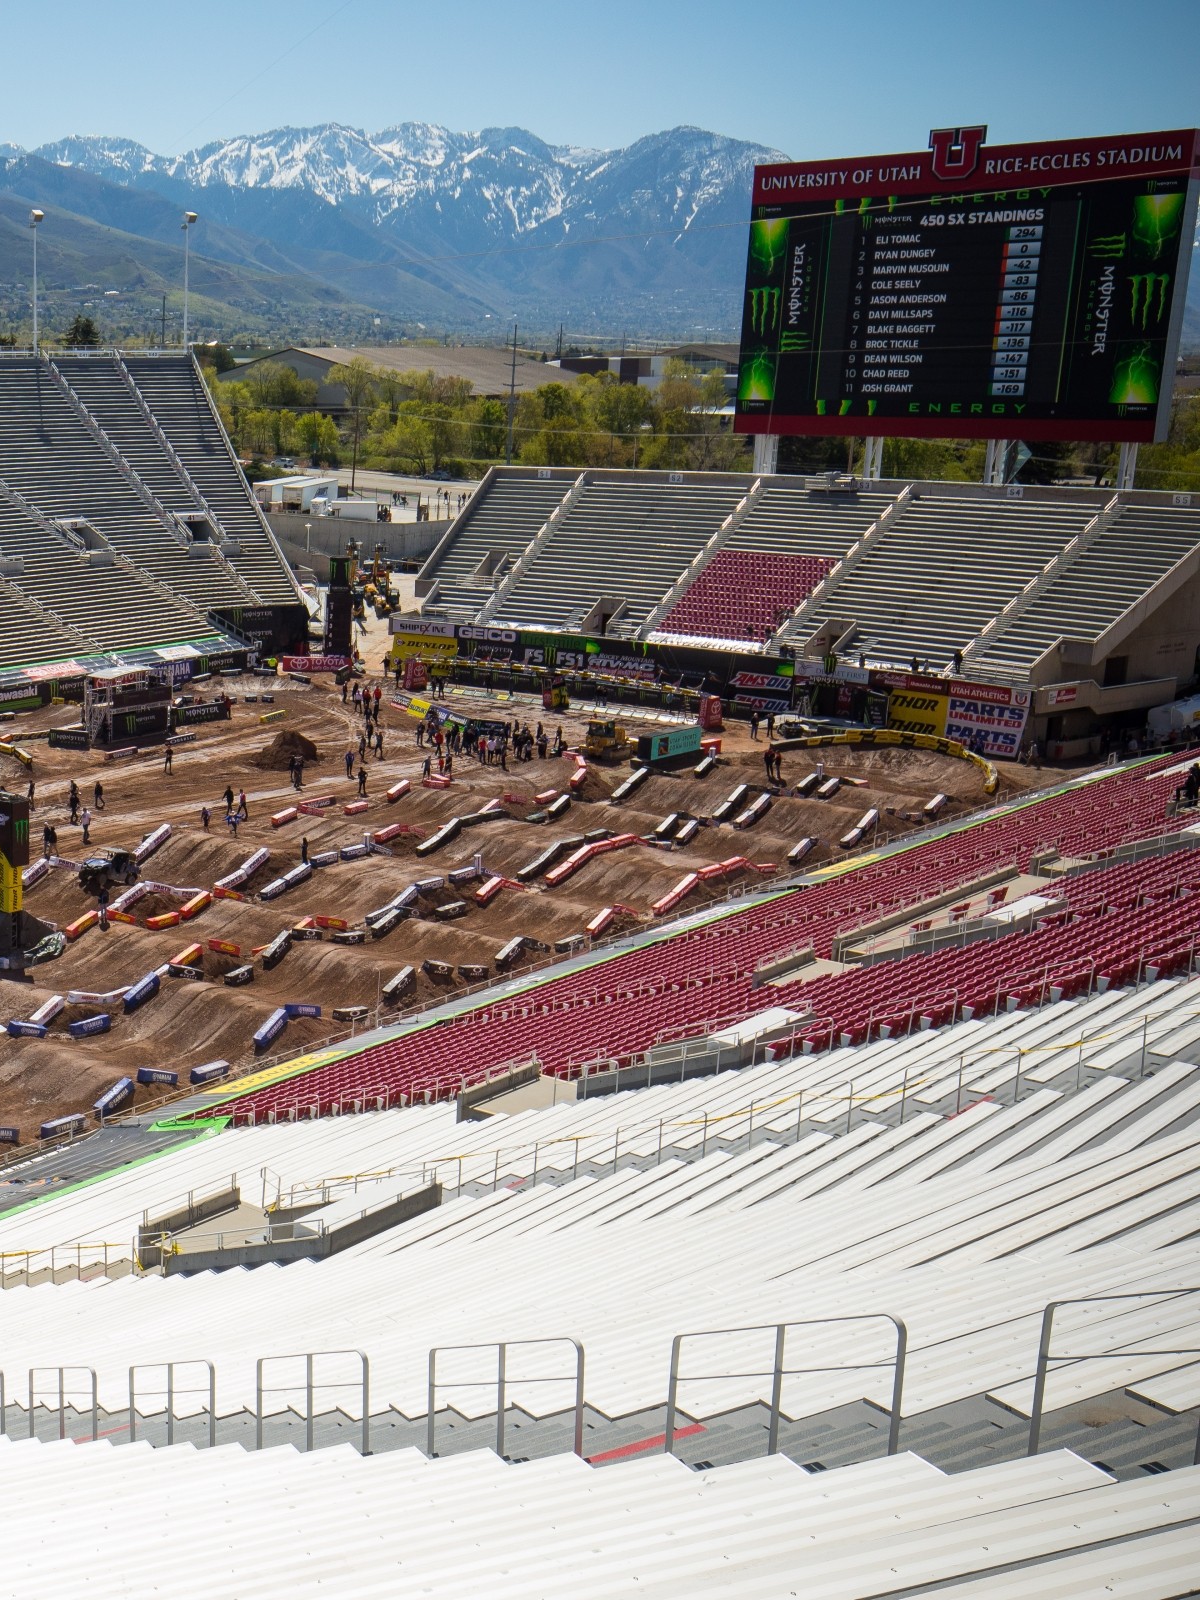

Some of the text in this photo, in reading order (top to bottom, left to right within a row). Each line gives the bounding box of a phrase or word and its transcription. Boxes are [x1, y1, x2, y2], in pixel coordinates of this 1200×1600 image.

[985, 145, 1183, 174] RICE-ECCLES STADIUM
[761, 165, 921, 191] UNIVERSITY OF UTAH
[930, 187, 1052, 206] ENERGY
[920, 209, 1044, 226] 450 SX STANDINGS
[861, 228, 1036, 245] 1 ELI TOMAC 294
[858, 245, 1029, 260] 2 RYAN DUNGEY 0
[857, 260, 1031, 275] 3 MARVIN MUSQUIN -42
[787, 244, 807, 325] MONSTER
[855, 276, 1029, 290] 4 COLE SEELY -83
[854, 291, 1028, 305] 5 JASON ANDERSON -86
[852, 307, 1027, 320] 6 DAVI MILLSAPS -116
[1091, 265, 1115, 356] MONSTER
[852, 323, 1025, 335] 7 BLAKE BAGGETT -117
[850, 338, 1024, 349] 8 BROC TICKLE -136
[848, 354, 1023, 364] 9 DEAN WILSON -147
[844, 369, 1020, 378] 10 CHAD REED -151
[845, 384, 1019, 394] 11 JOSH GRANT -169
[908, 403, 1026, 413] ENERGY
[432, 626, 447, 634] INC
[458, 626, 517, 643] GEICO
[406, 640, 455, 651] DUNLOP
[311, 658, 345, 666] TOYOTA
[556, 651, 584, 668] FS1
[733, 673, 793, 690] AMSOIL
[810, 675, 846, 685] MONSTER
[846, 670, 867, 680] FIRST
[951, 687, 1010, 701] UTAH ATHLETICS
[890, 694, 939, 712] THOR
[950, 699, 1025, 720] PARTS
[185, 706, 219, 717] MONSTER
[949, 710, 1022, 728] UNLIMITED
[889, 718, 937, 735] THOR
[56, 734, 86, 743] MONSTER
[946, 724, 1017, 745] PARTS
